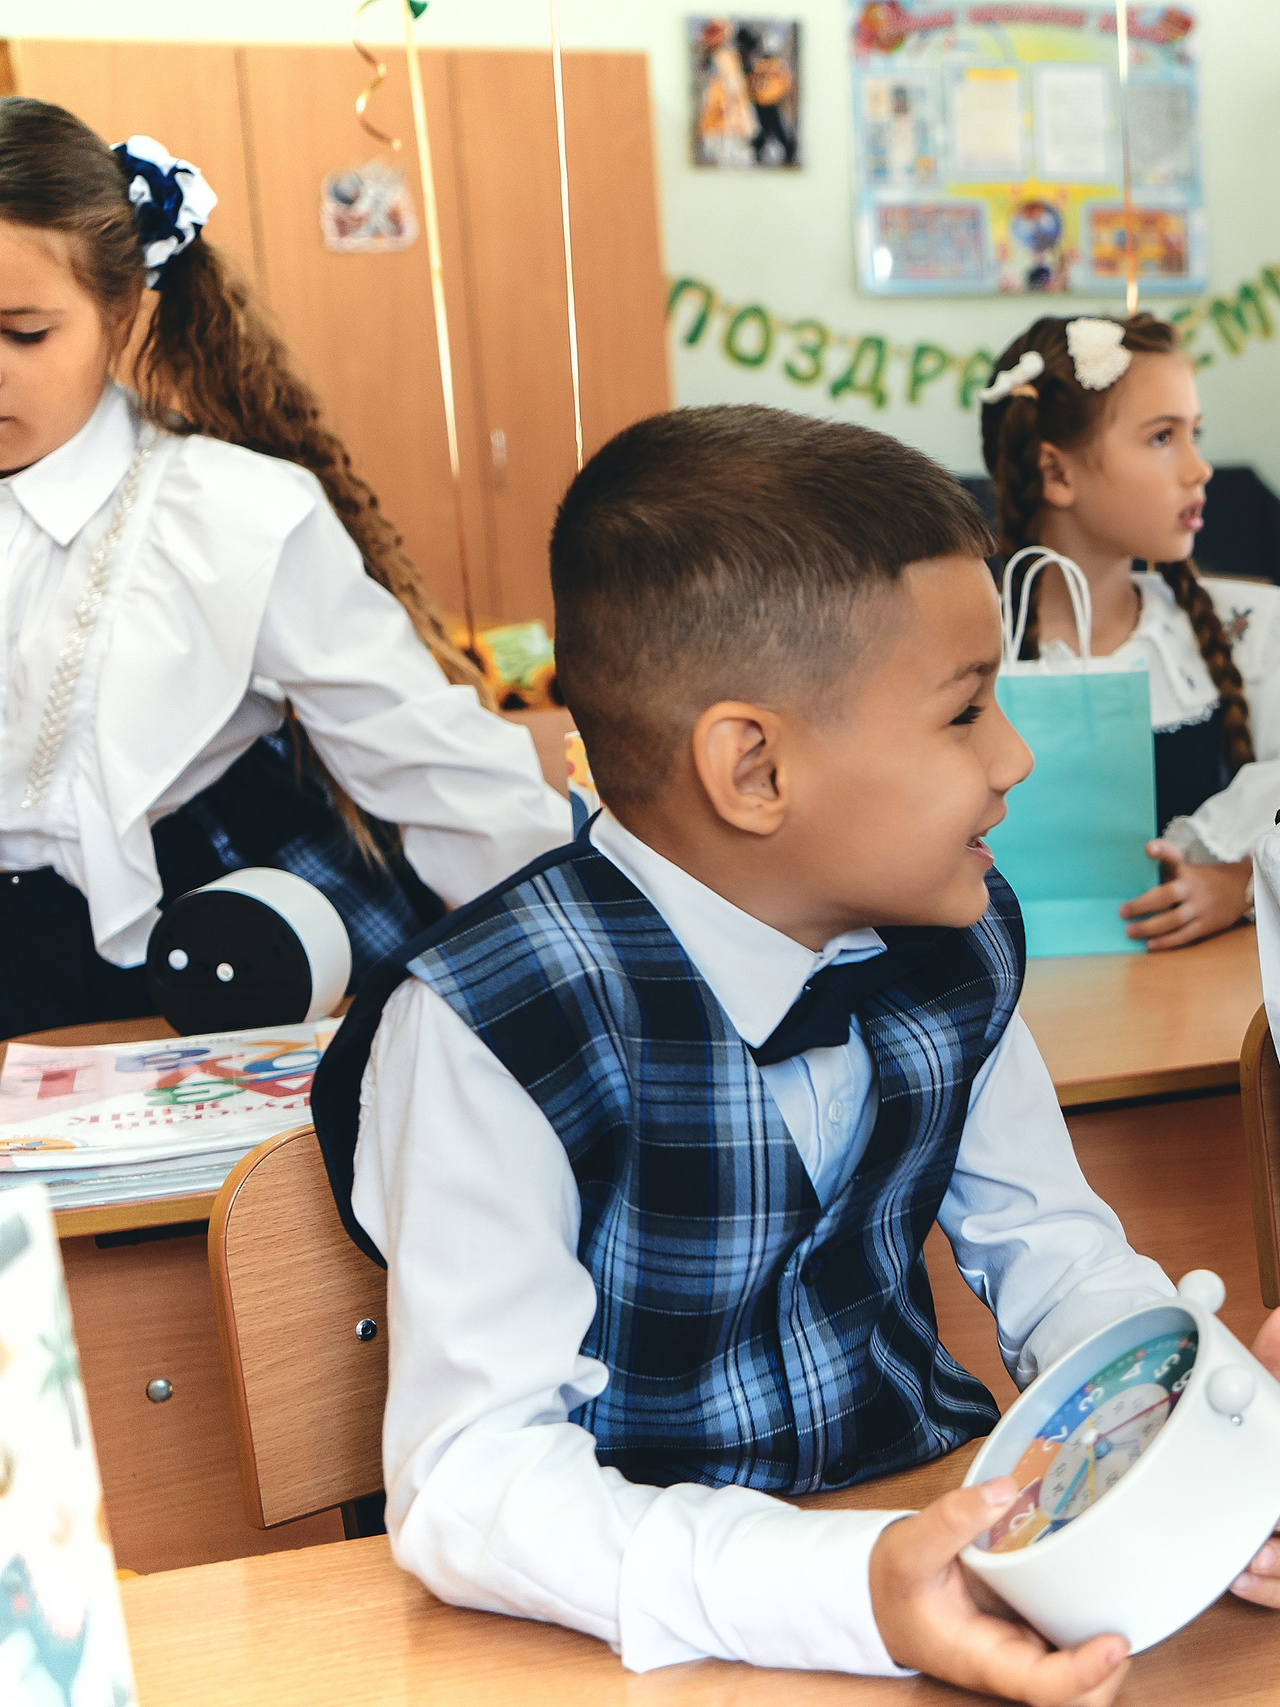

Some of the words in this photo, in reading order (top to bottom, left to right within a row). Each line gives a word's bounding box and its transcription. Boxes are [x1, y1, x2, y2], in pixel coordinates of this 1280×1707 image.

[1119, 1361, 1144, 1382] 4
[1154, 1353, 1180, 1379] 5
[1172, 1369, 1193, 1392] 6
[1079, 1386, 1105, 1411] 3
[1042, 1426, 1069, 1452] 2
[1008, 1502, 1036, 1536] 12
